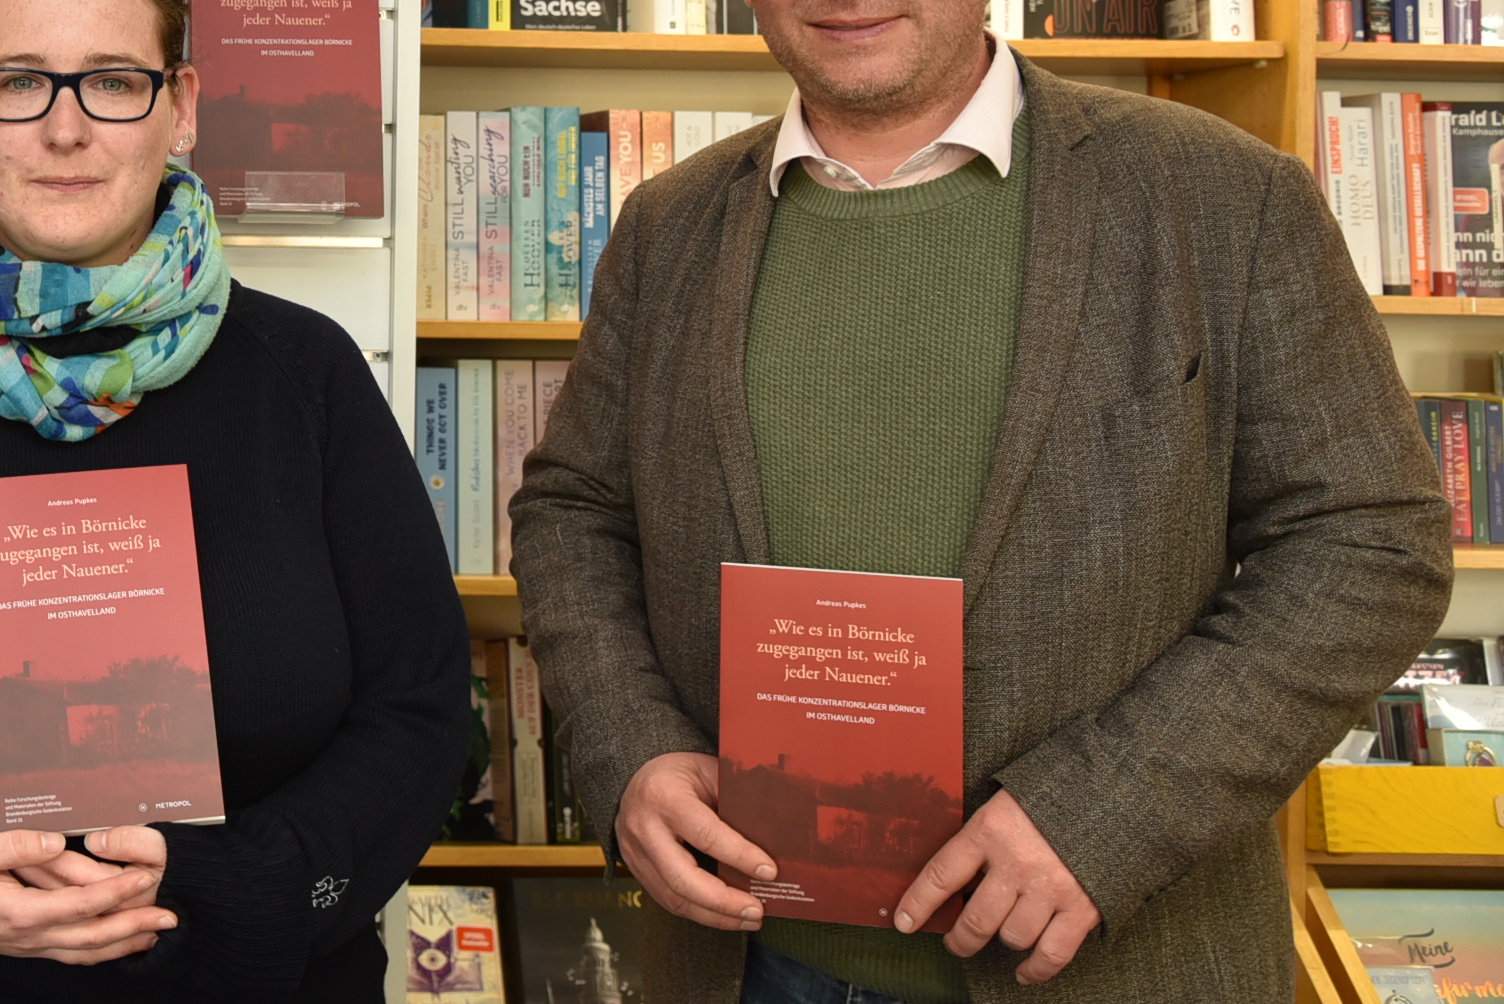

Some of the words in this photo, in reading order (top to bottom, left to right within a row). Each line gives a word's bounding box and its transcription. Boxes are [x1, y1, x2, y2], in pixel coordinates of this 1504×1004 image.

[464, 154, 475, 188] YOU
[451, 198, 464, 241] STILL
[1453, 411, 1464, 449] LOVE
[1455, 452, 1466, 493] PRAY
[48, 499, 73, 507] Andreas
[75, 497, 97, 505] Pupkes
[1457, 497, 1467, 522] EAT
[4, 525, 38, 542] „Wie
[43, 525, 56, 537] es
[62, 522, 76, 535] in
[81, 515, 146, 533] Börnicke
[83, 541, 104, 554] ist,
[108, 535, 143, 551] weiß
[147, 537, 160, 552] ja
[22, 568, 57, 587] jeder
[63, 558, 133, 579] Nauener.“
[13, 598, 36, 609] FRÜHE
[39, 591, 127, 606] KONZENTRATIONSLAGER
[129, 588, 165, 598] BÖRNICKE
[816, 600, 842, 608] Andreas
[58, 607, 116, 618] OSTHAVELLAND
[769, 619, 804, 635] „Wie
[809, 625, 822, 636] es
[828, 624, 842, 637] in
[848, 624, 914, 643] Börnicke
[757, 643, 841, 662] zugegangen
[847, 647, 868, 662] ist,
[874, 649, 909, 664] weiß
[913, 652, 927, 668] ja
[784, 664, 820, 682] jeder
[824, 667, 897, 685] Nauener.“
[757, 693, 772, 701] DAS
[773, 694, 797, 703] FRÜHE
[799, 697, 887, 711] KONZENTRATIONSLAGER
[889, 704, 925, 714] BÖRNICKE
[817, 713, 874, 724] OSTHAVELLAND
[155, 801, 191, 809] METROPOL
[1407, 941, 1453, 964] Meine
